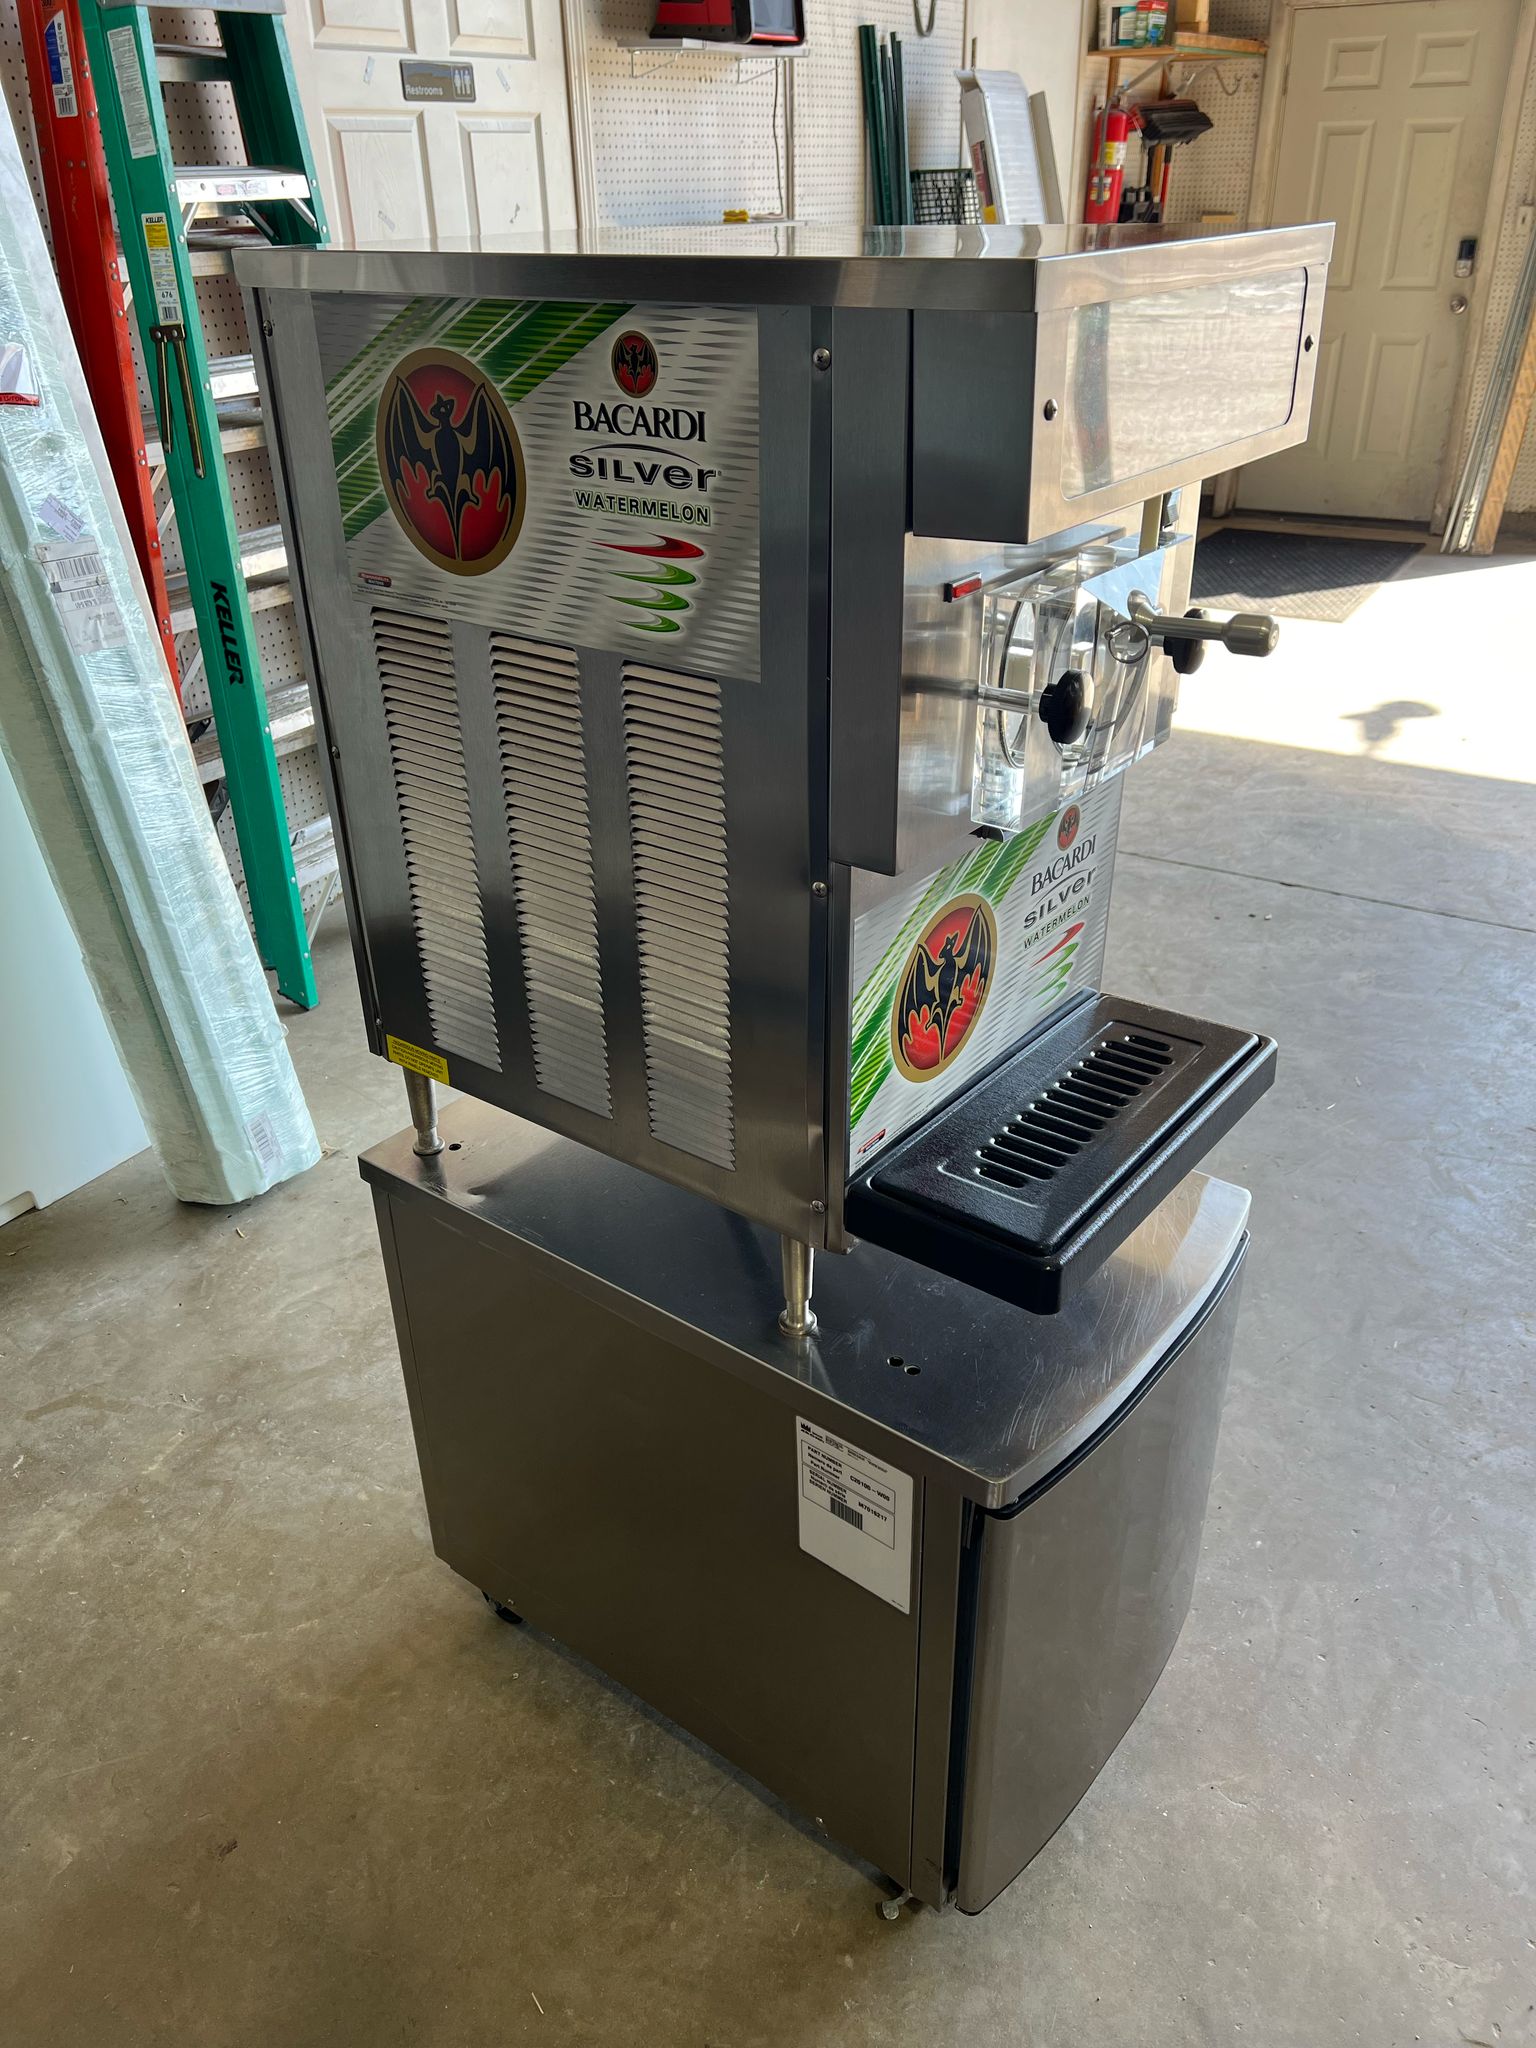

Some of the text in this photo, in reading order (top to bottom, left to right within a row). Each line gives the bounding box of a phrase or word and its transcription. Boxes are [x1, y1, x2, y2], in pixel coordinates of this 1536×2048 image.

[405, 84, 443, 96] Restrooms
[145, 216, 164, 224] KELLER
[573, 400, 707, 442] BACARDI
[573, 489, 710, 526] WATERMELON
[210, 580, 244, 686] KELLER
[1031, 834, 1097, 896] BACARDI
[1023, 895, 1090, 950] WATERMELON
[808, 1446, 821, 1456] PART
[821, 1453, 842, 1468] NUMBER
[809, 1470, 847, 1494] SERIAL NUMBER
